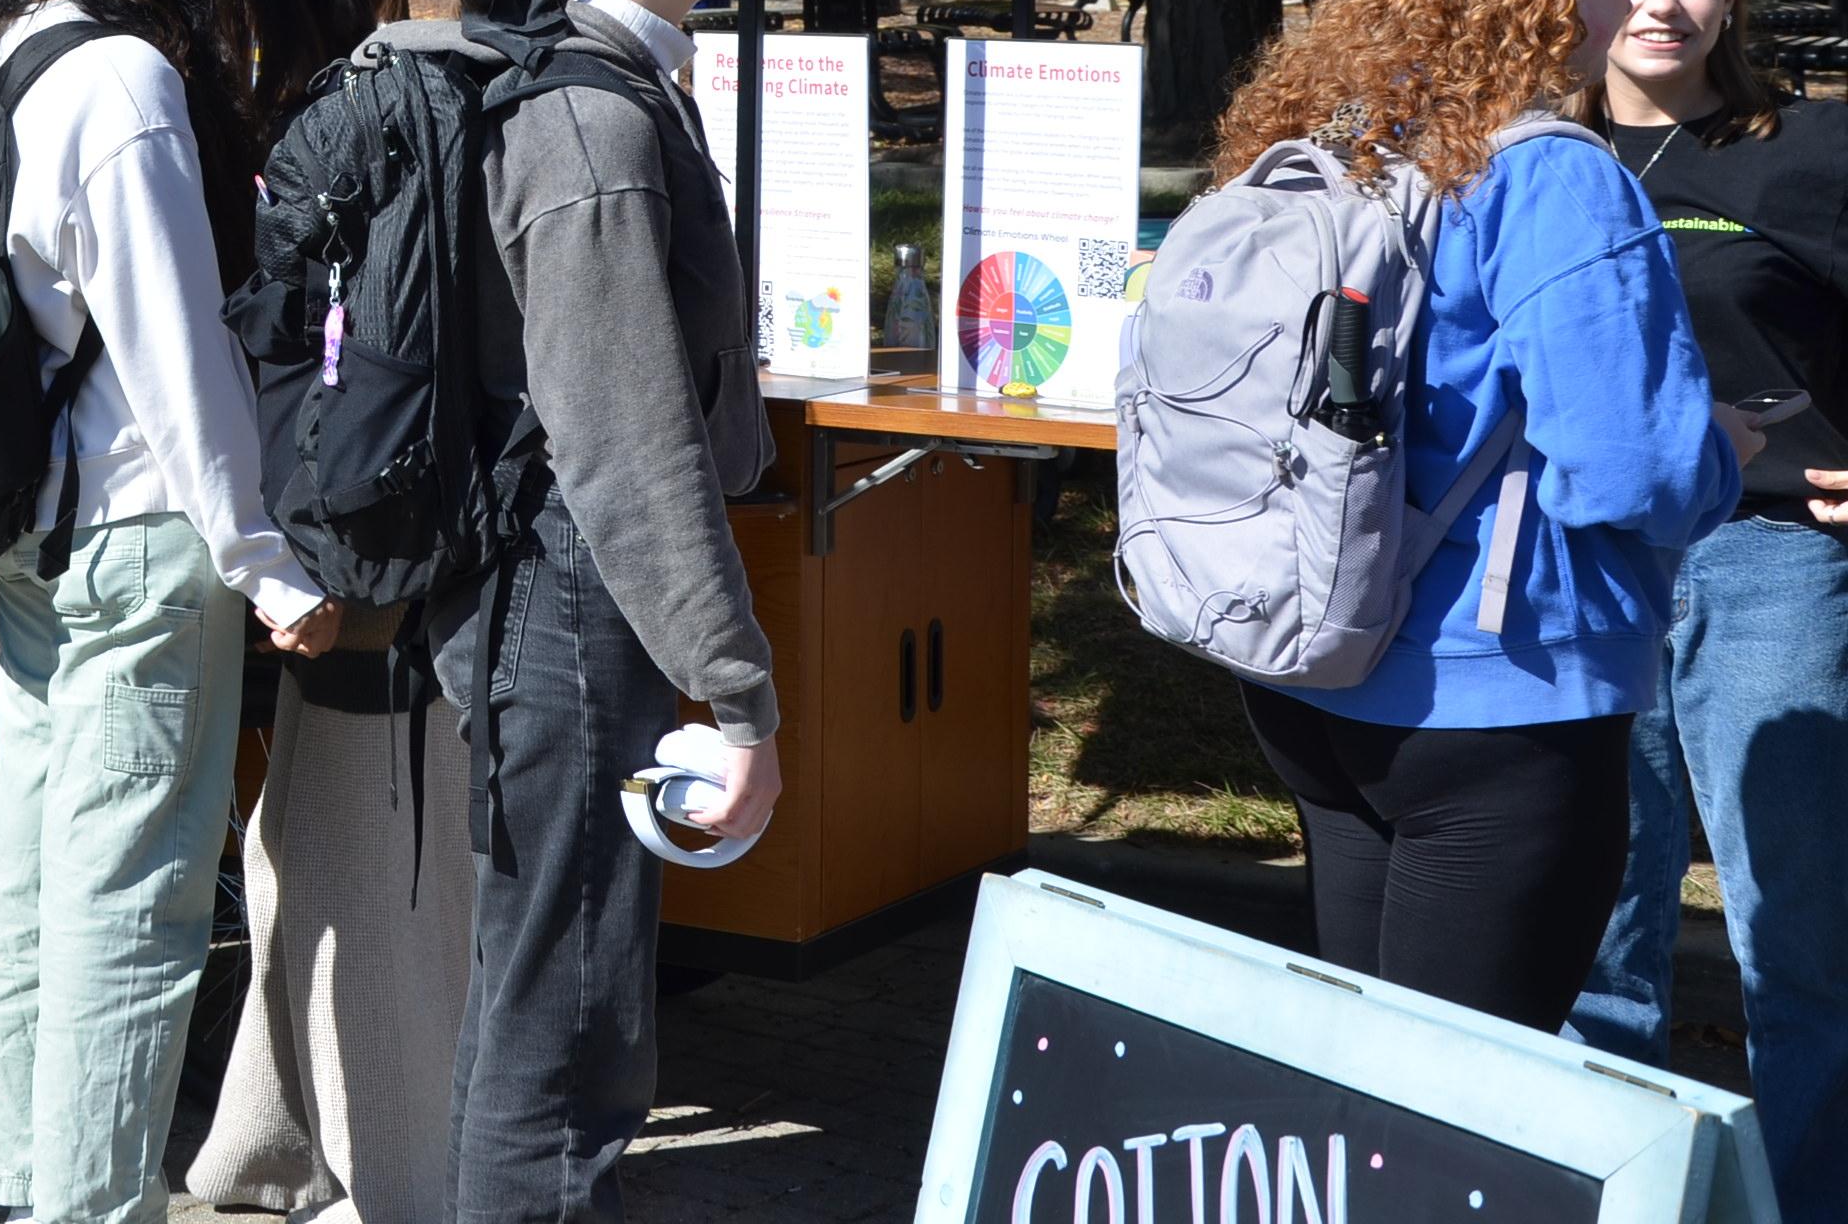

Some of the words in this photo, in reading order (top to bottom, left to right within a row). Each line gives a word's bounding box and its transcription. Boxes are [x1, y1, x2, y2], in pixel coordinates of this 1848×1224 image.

[798, 56, 813, 71] to
[819, 56, 844, 72] the
[967, 59, 1033, 79] Climate
[1039, 64, 1121, 83] Emotions
[712, 76, 783, 98] Chang
[788, 78, 849, 96] Climate
[1009, 207, 1024, 217] feel
[1026, 208, 1049, 219] about
[1051, 211, 1081, 222] climate
[963, 226, 996, 238] Climate
[998, 229, 1038, 241] Emotions
[1041, 232, 1068, 243] Wheel
[1012, 1122, 1347, 1224] COTTON
